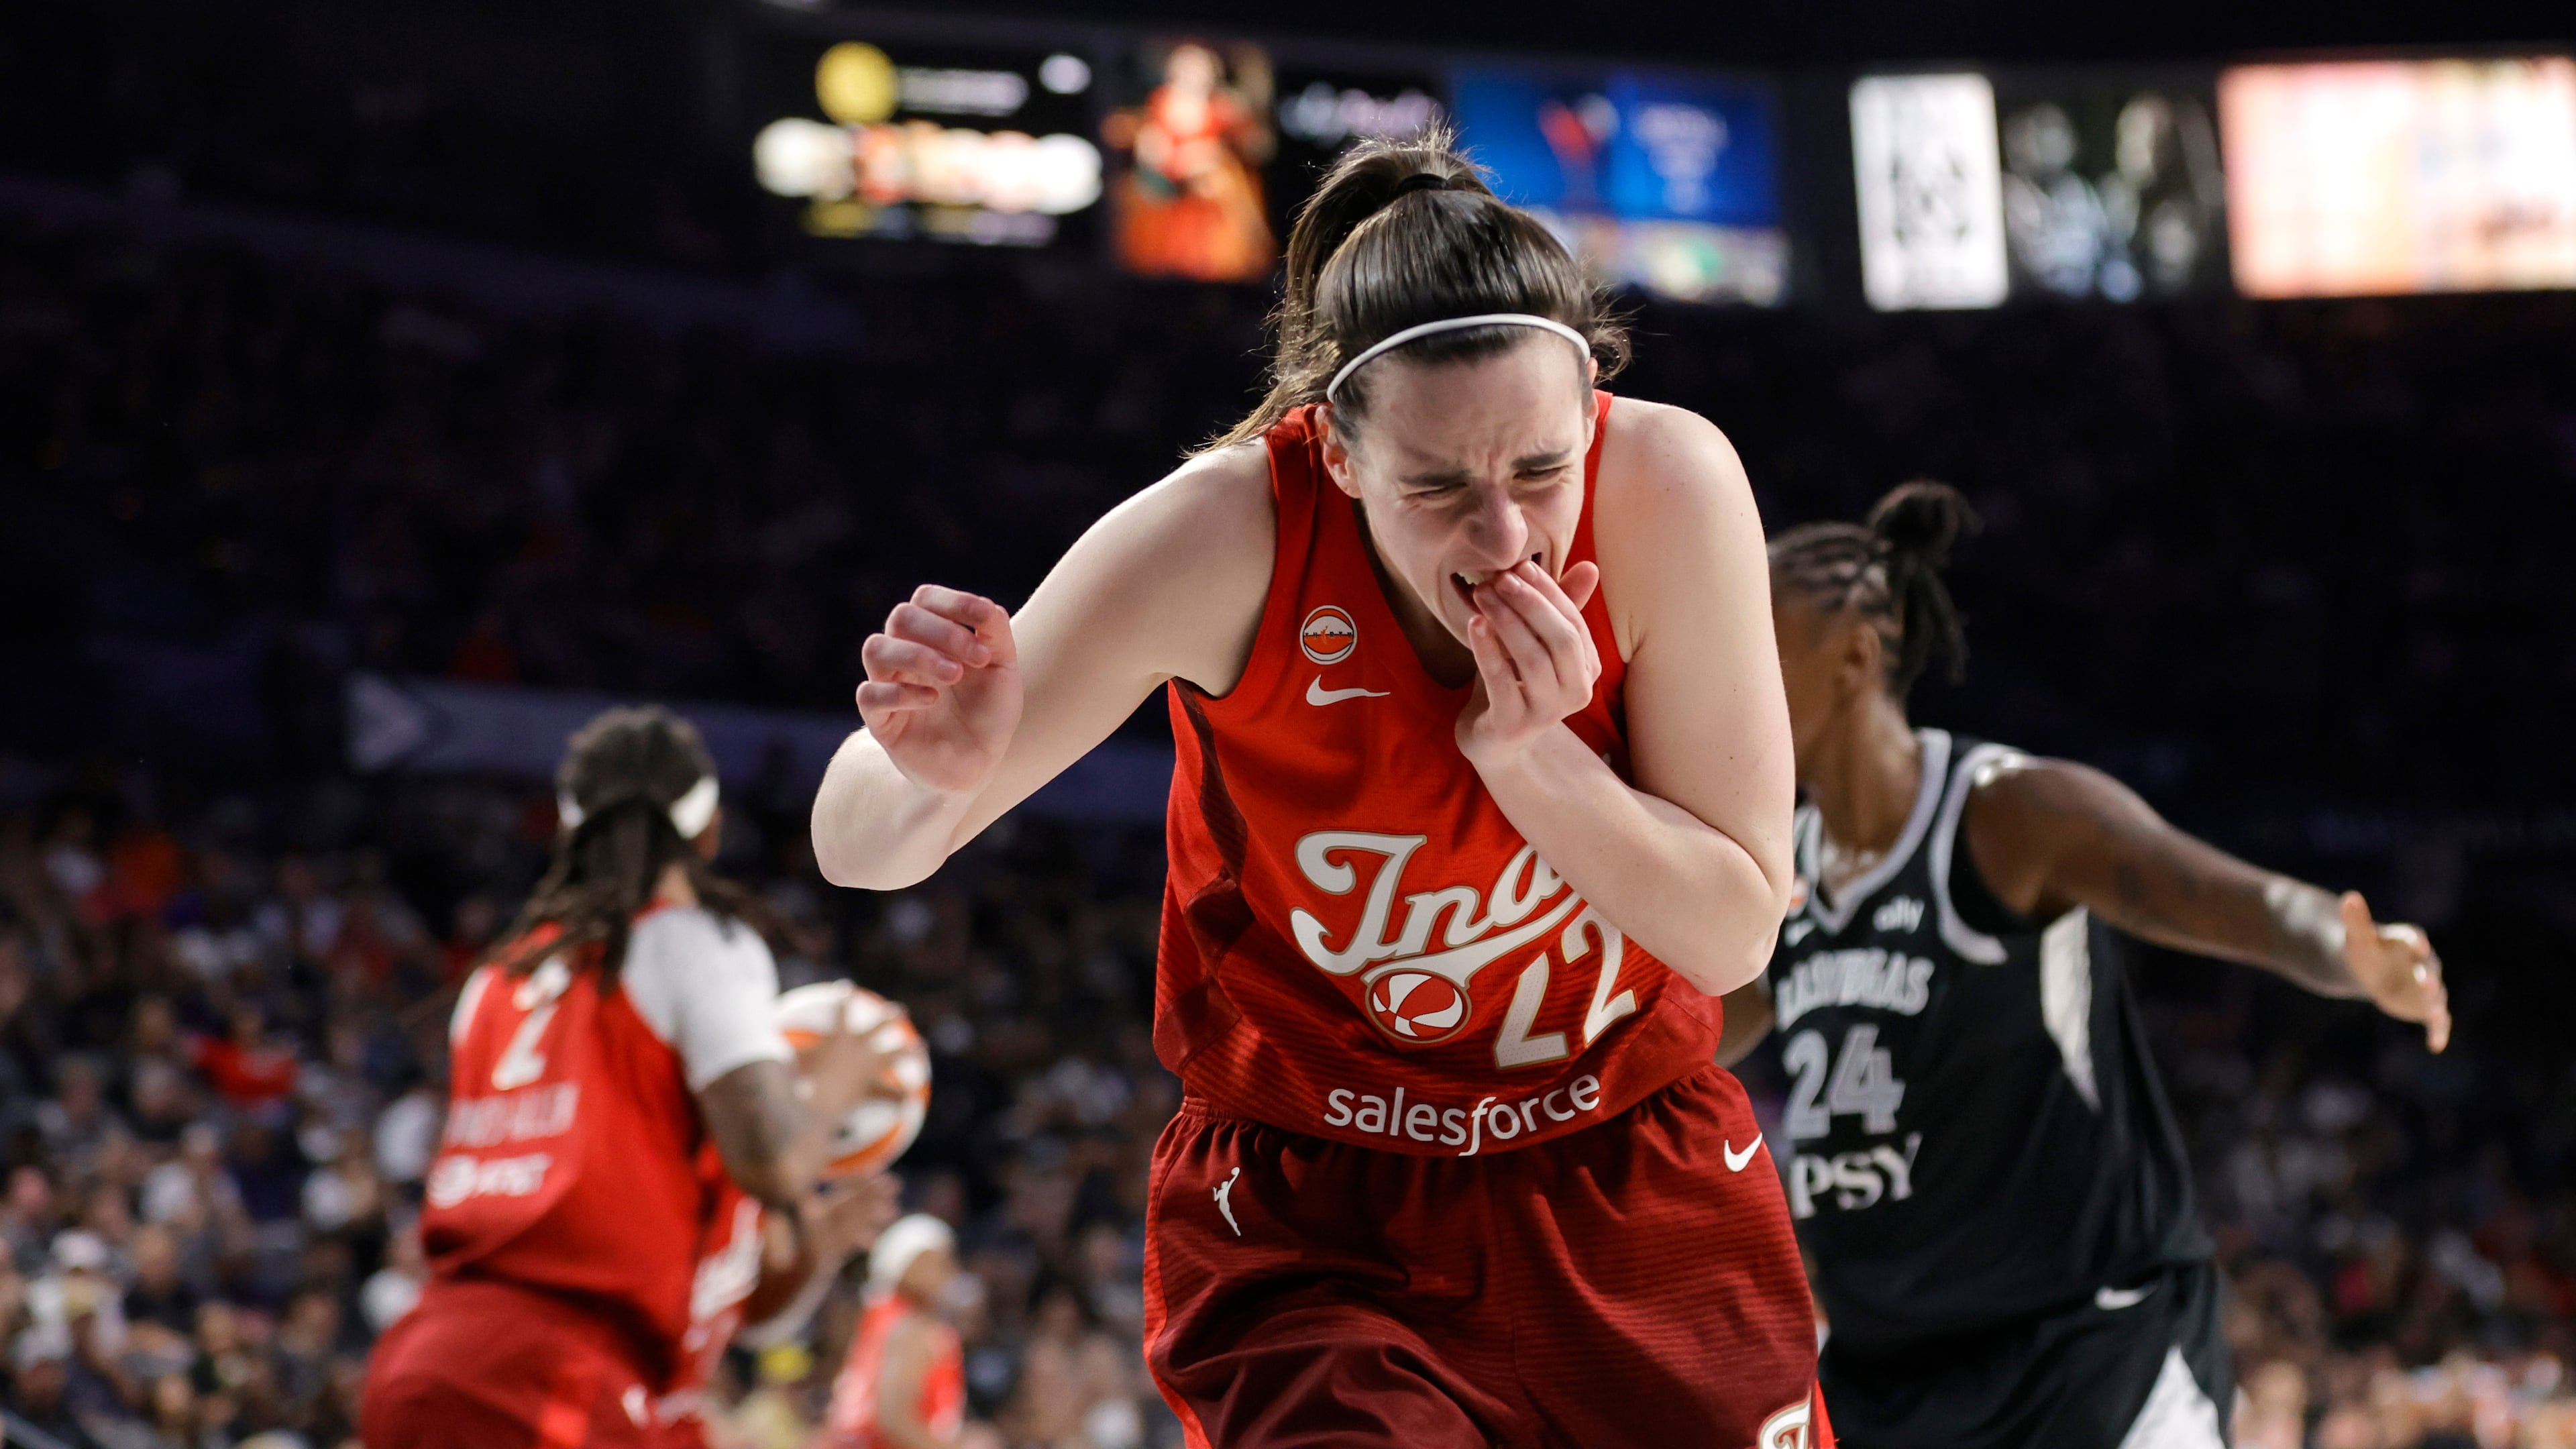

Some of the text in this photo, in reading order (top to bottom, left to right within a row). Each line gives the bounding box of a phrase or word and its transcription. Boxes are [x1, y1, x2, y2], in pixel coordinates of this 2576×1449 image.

[1872, 894, 1925, 934] ally
[490, 955, 570, 1091] 2
[1493, 906, 1637, 1070] 22
[1323, 1073, 1601, 1157] salesforce
[1781, 1022, 1907, 1139] 24
